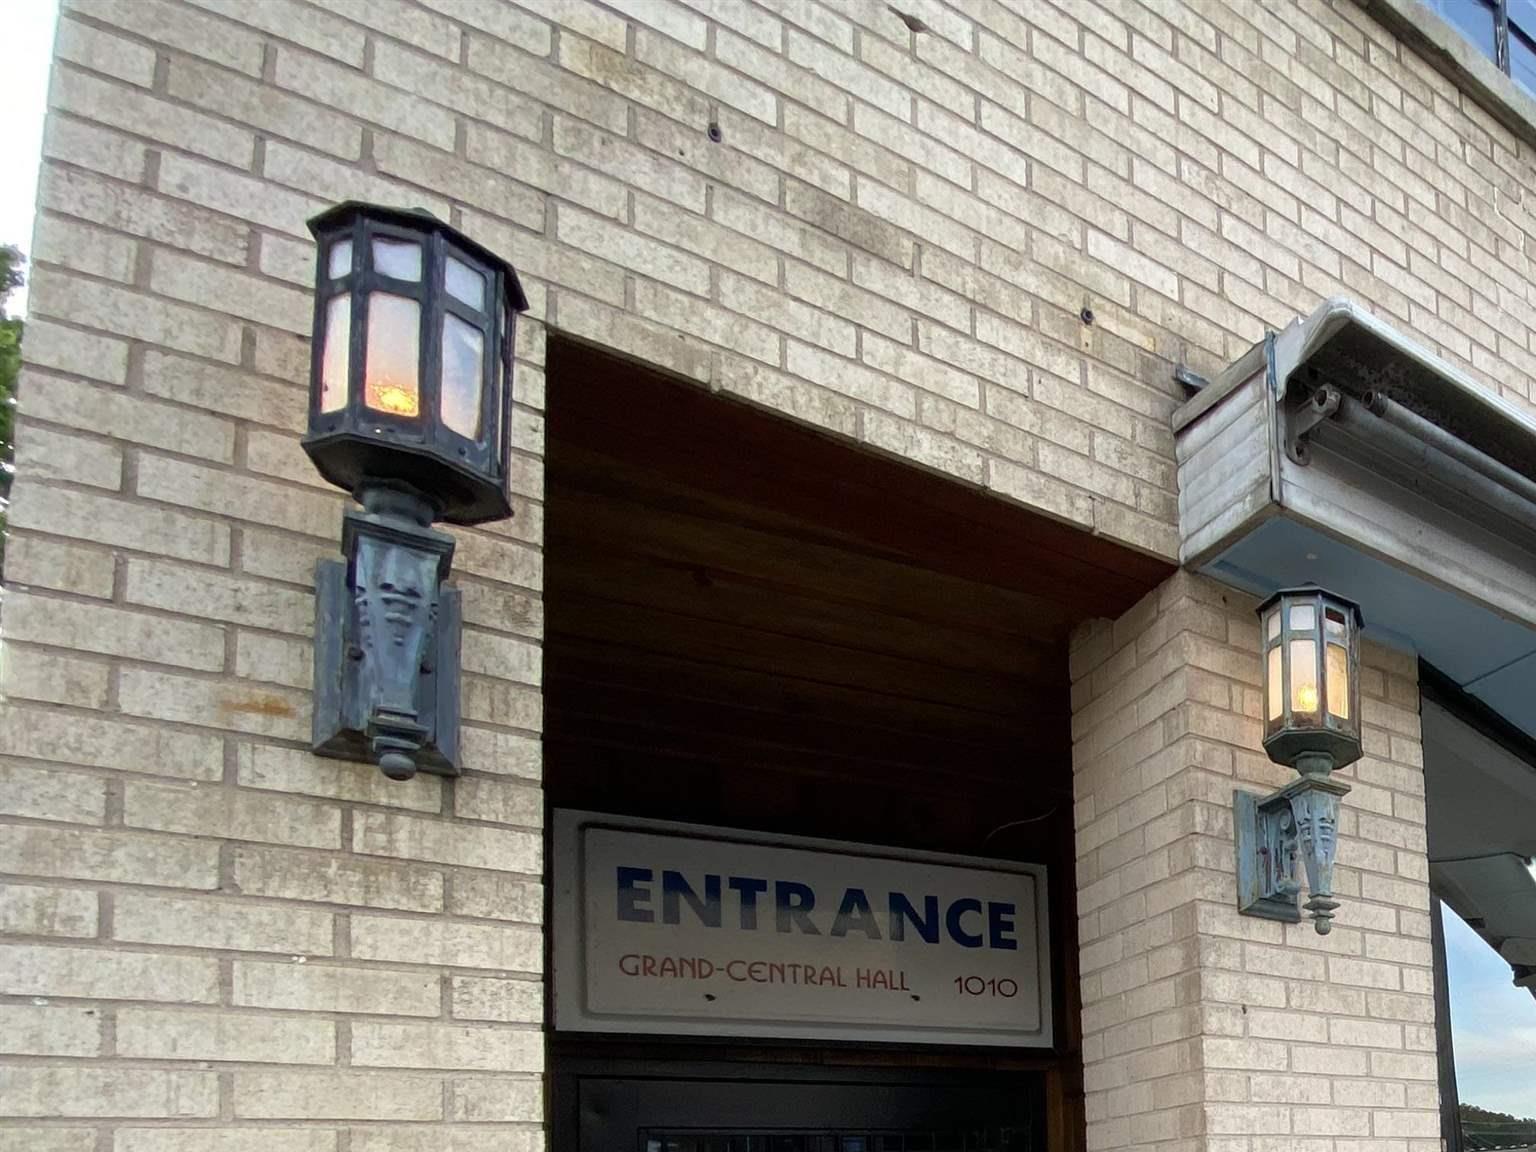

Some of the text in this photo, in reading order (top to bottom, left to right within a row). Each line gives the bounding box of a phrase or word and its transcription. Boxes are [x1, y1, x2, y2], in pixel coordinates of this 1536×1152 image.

[615, 865, 1019, 951] ENTRANCE
[618, 953, 1019, 999] GRAND-CENTRAL HALL 1010
